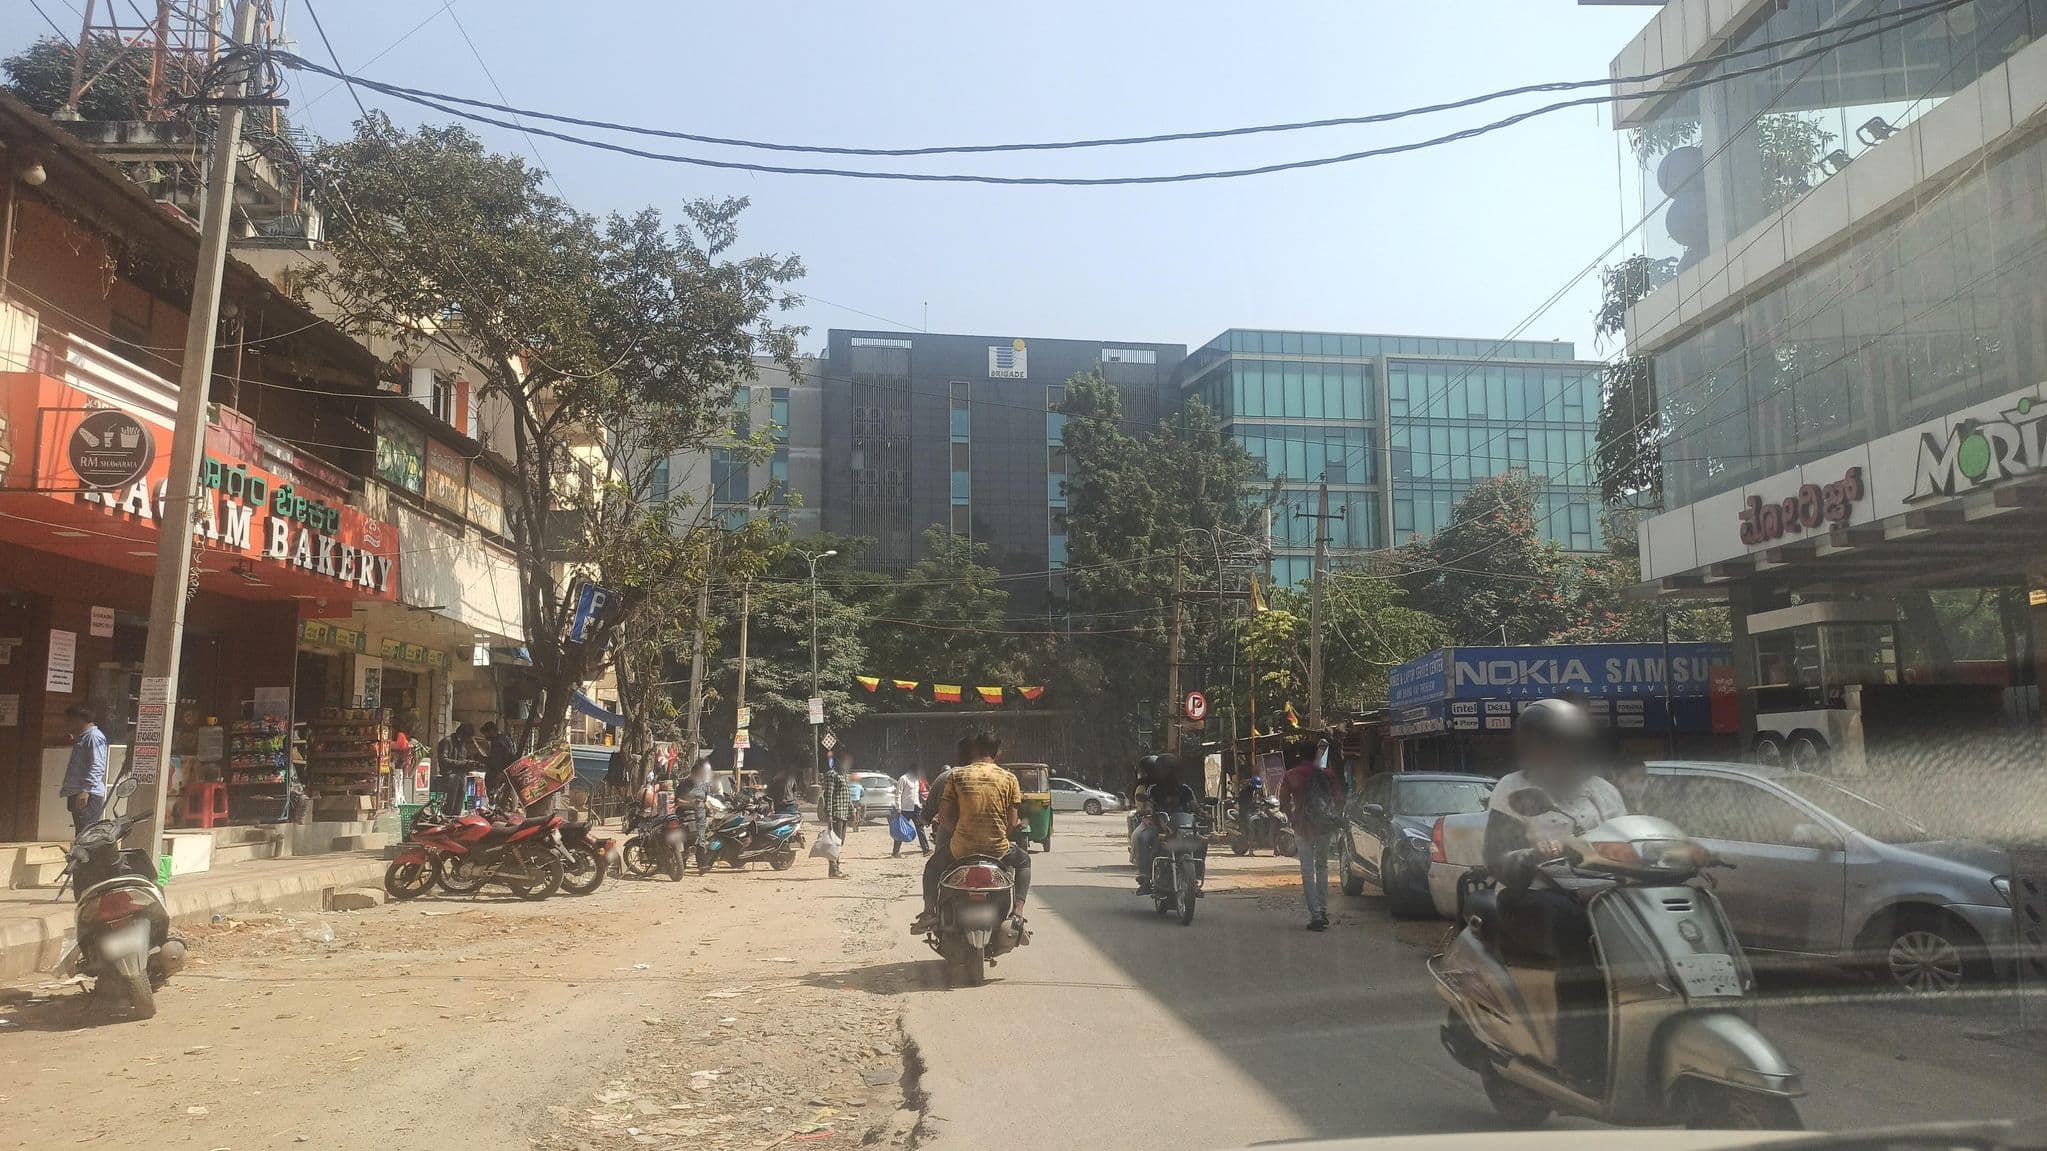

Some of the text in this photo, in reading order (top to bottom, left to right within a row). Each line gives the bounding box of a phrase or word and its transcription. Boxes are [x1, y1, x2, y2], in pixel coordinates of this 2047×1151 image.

[991, 370, 1025, 378] BRIGADE
[1903, 397, 2047, 505] MORI
[80, 456, 138, 469] RM SHAWARMA
[269, 516, 393, 593] BAKERY
[589, 591, 606, 614] P
[1455, 658, 1593, 686] NOKIA
[1453, 703, 1478, 713] intel
[1487, 704, 1508, 712] DELL
